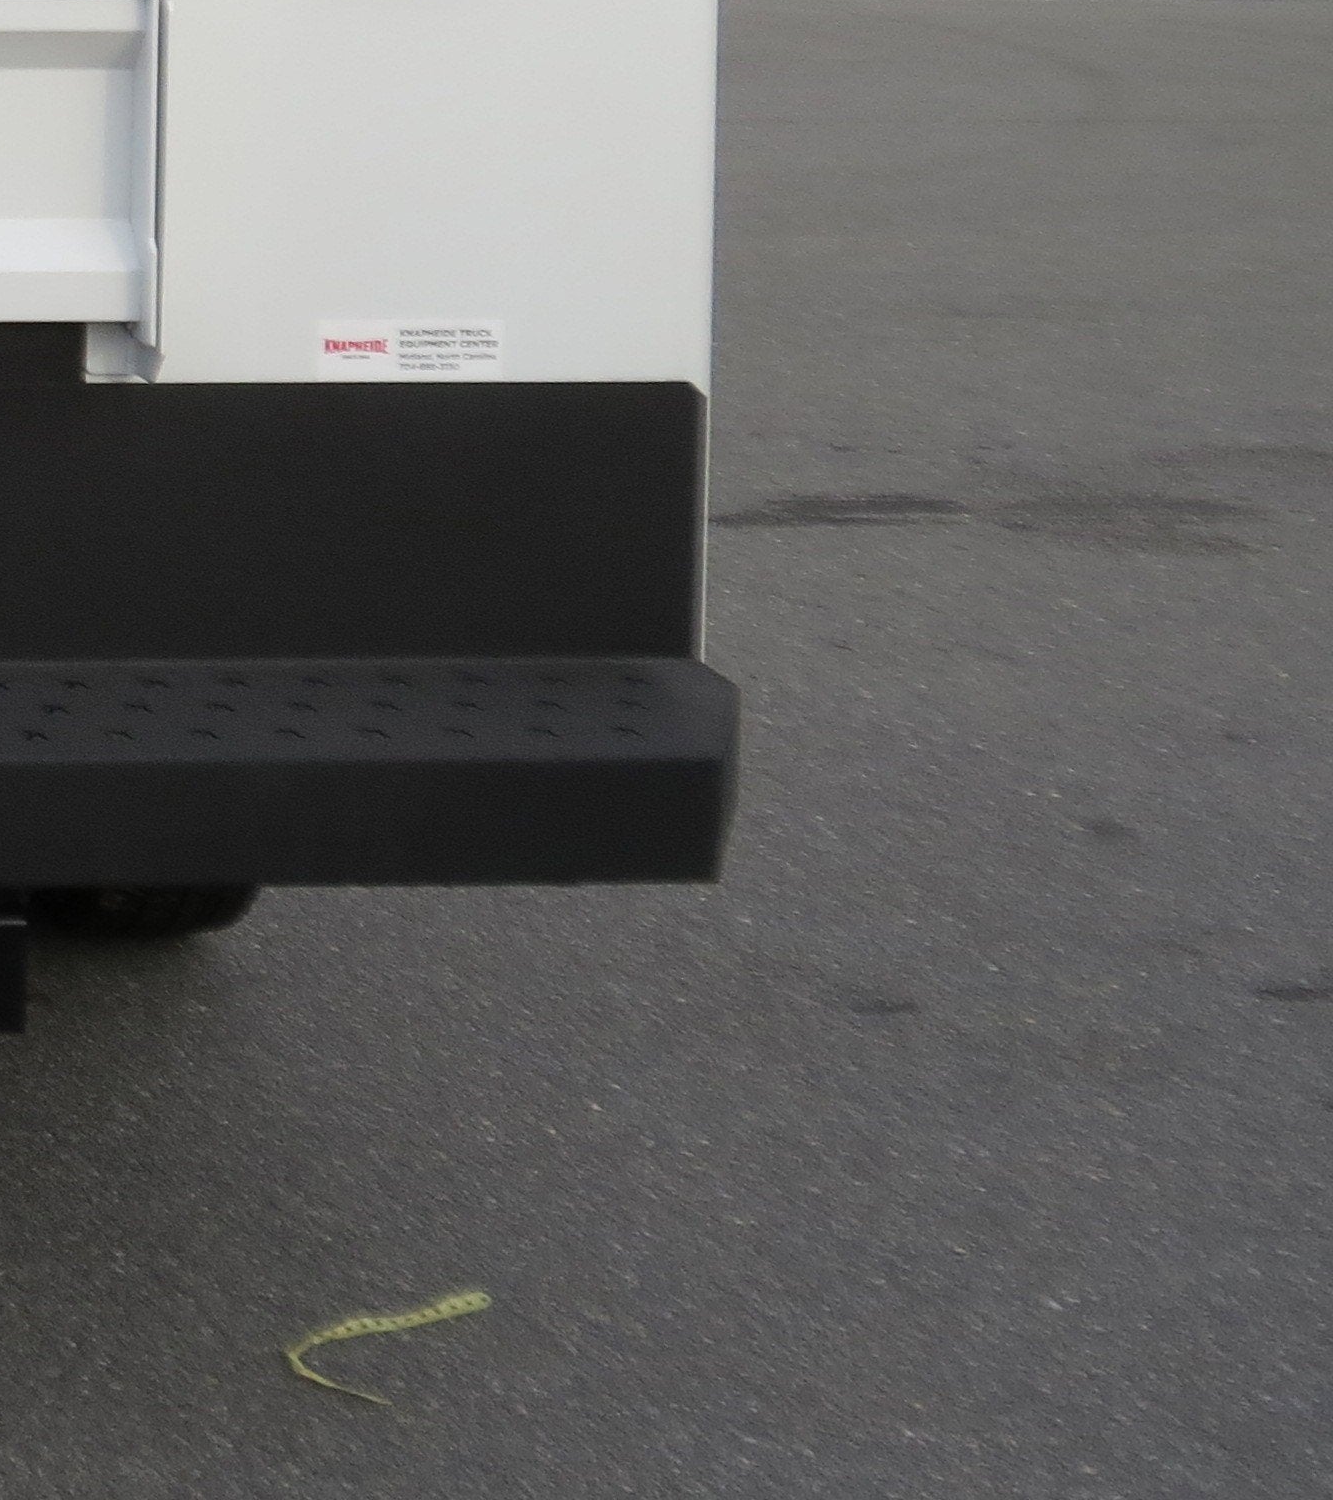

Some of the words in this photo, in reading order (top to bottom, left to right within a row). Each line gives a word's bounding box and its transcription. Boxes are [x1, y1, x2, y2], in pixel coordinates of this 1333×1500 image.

[460, 329, 493, 337] TRUCK
[324, 338, 389, 354] KNAPHEIDE
[399, 340, 457, 348] EQUIPMENT
[460, 340, 499, 348] CENTER
